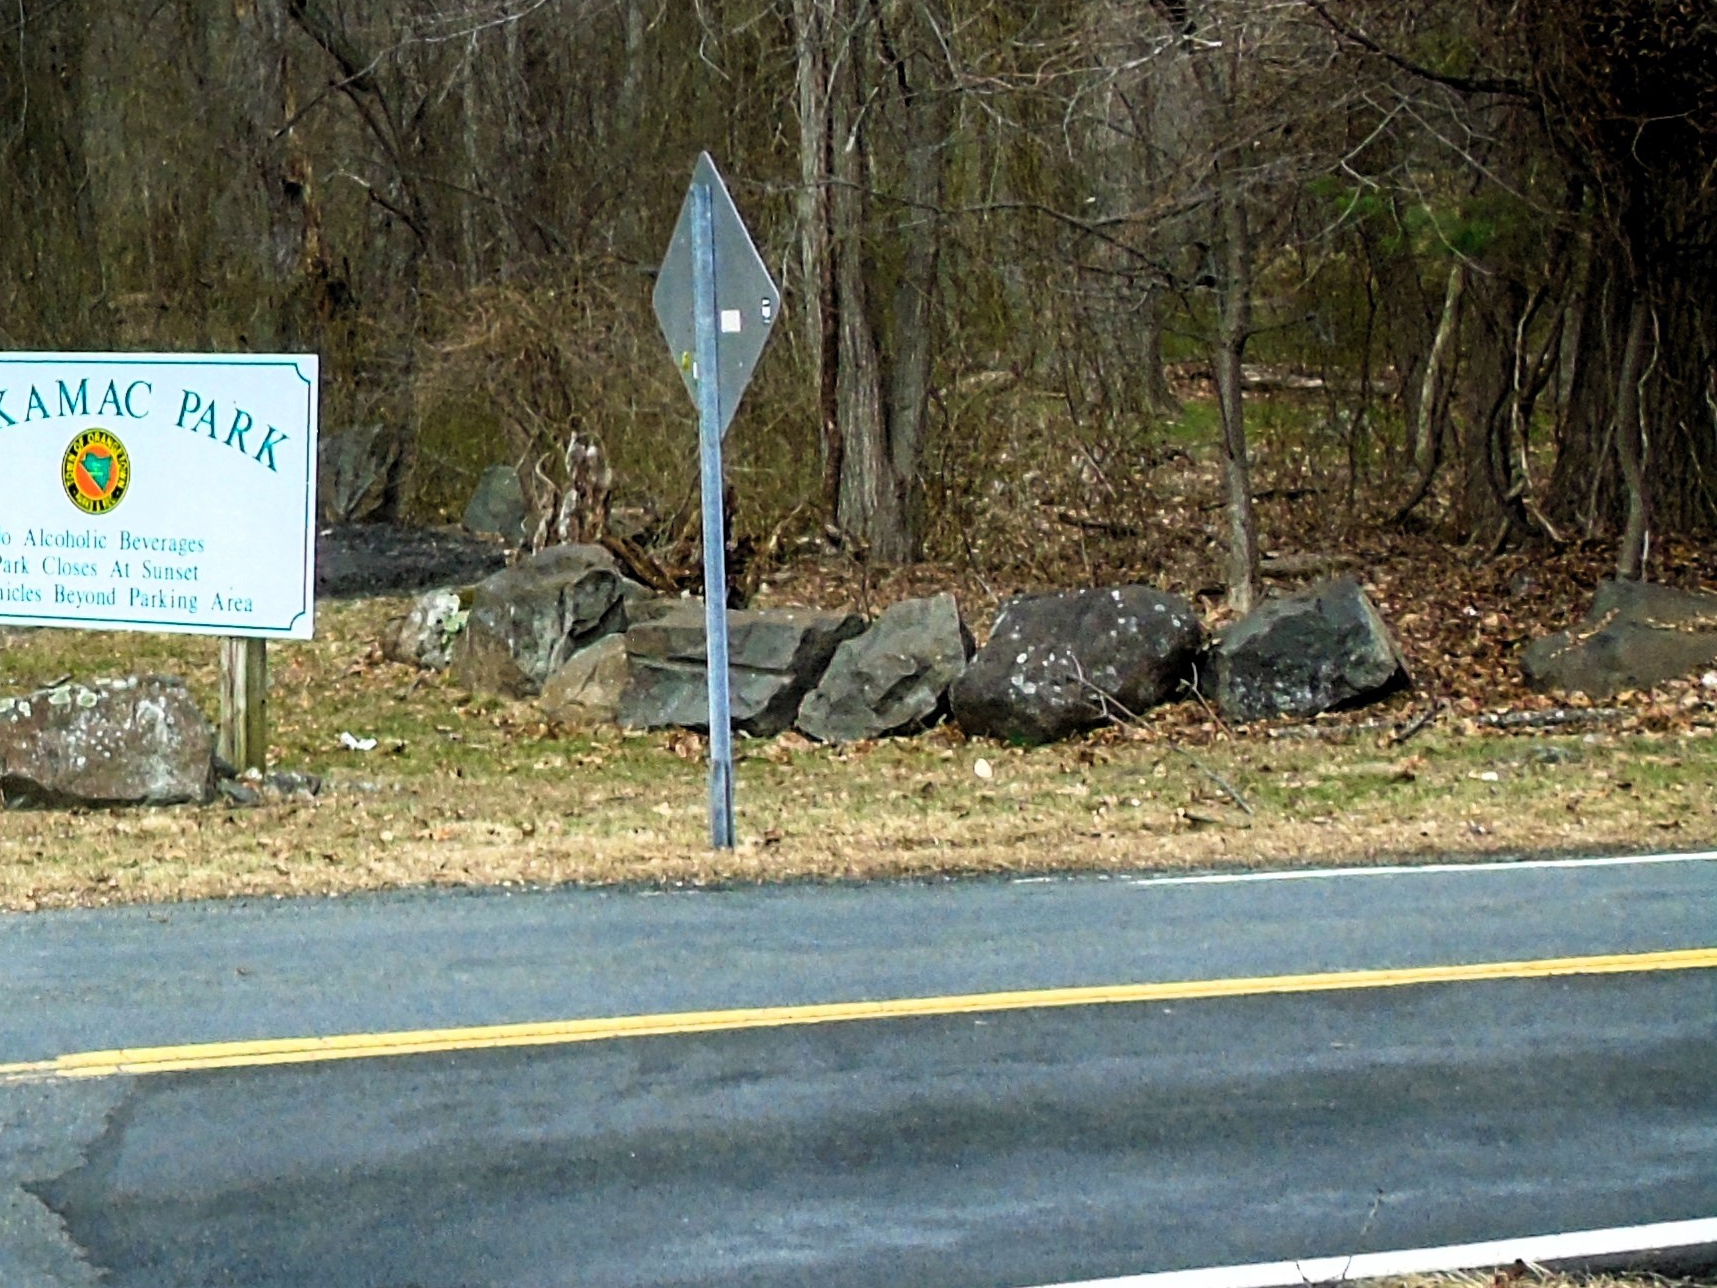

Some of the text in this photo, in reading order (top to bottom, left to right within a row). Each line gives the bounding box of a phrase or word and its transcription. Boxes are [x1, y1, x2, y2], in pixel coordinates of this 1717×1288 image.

[175, 389, 290, 473] PARK
[24, 528, 107, 549] Alcoholic
[120, 530, 205, 556] Beverages
[42, 556, 97, 576] Closes
[110, 560, 130, 578] At
[142, 560, 198, 581] Sunset
[55, 584, 115, 608] Beyond
[129, 587, 198, 613] Parking
[211, 592, 253, 612] Area
